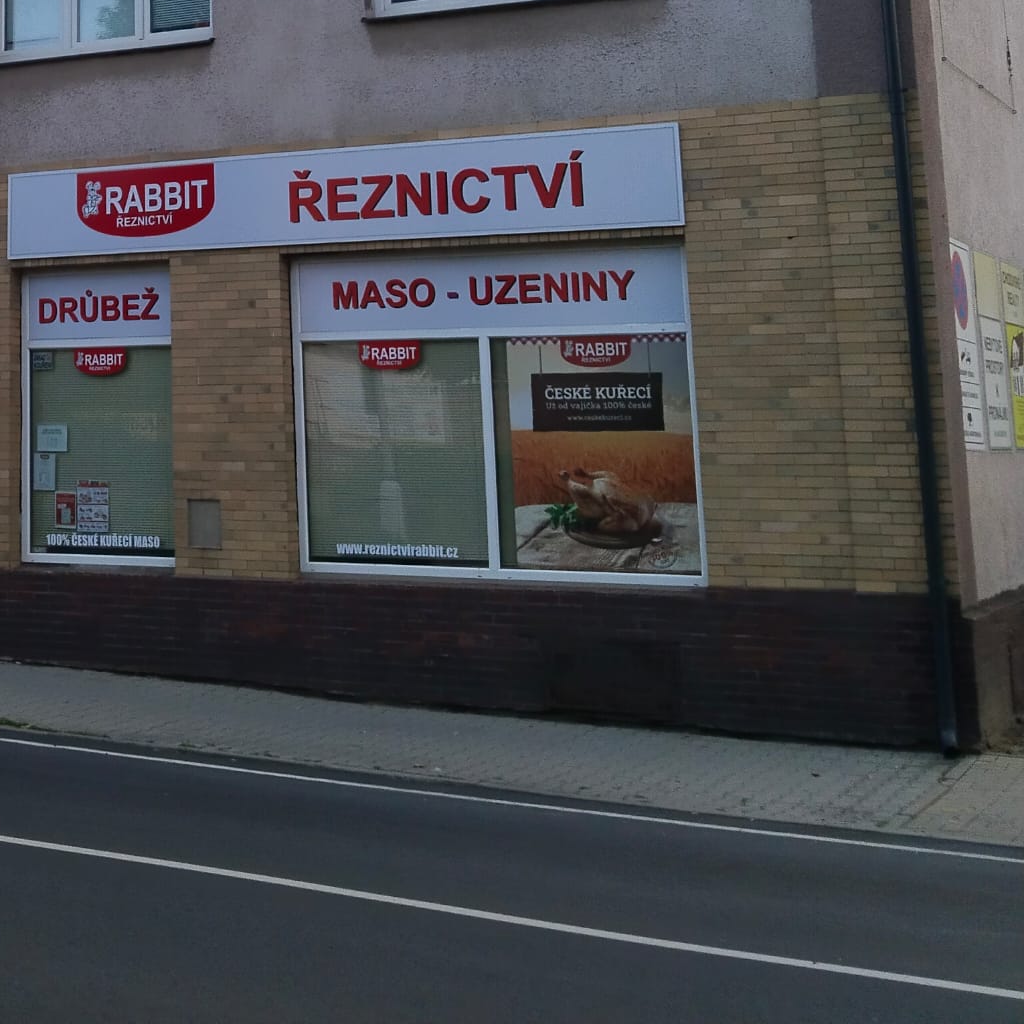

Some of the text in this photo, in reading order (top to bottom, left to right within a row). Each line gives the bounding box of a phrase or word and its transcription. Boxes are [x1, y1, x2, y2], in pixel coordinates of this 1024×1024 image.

[289, 150, 584, 223] ŘEZNICTVÍ
[105, 179, 208, 215] RABBIT
[116, 212, 173, 228] ŘEZNICTVÍ
[332, 278, 436, 310] MASO
[469, 269, 635, 306] UZENINY
[38, 287, 160, 324] DRŮBEŽ
[370, 346, 417, 360] RABBIT
[575, 341, 628, 356] RABBIT
[84, 353, 124, 366] RABBIT
[544, 383, 652, 400] ČESKÉ KUŘECÍ
[558, 401, 568, 409] od
[570, 400, 601, 411] vajíčka
[603, 401, 626, 409] 100%
[46, 533, 161, 549] 100% ČESKÉ KUŘECÍ MASO
[336, 541, 459, 559] www.reznictvirabbit.cz
